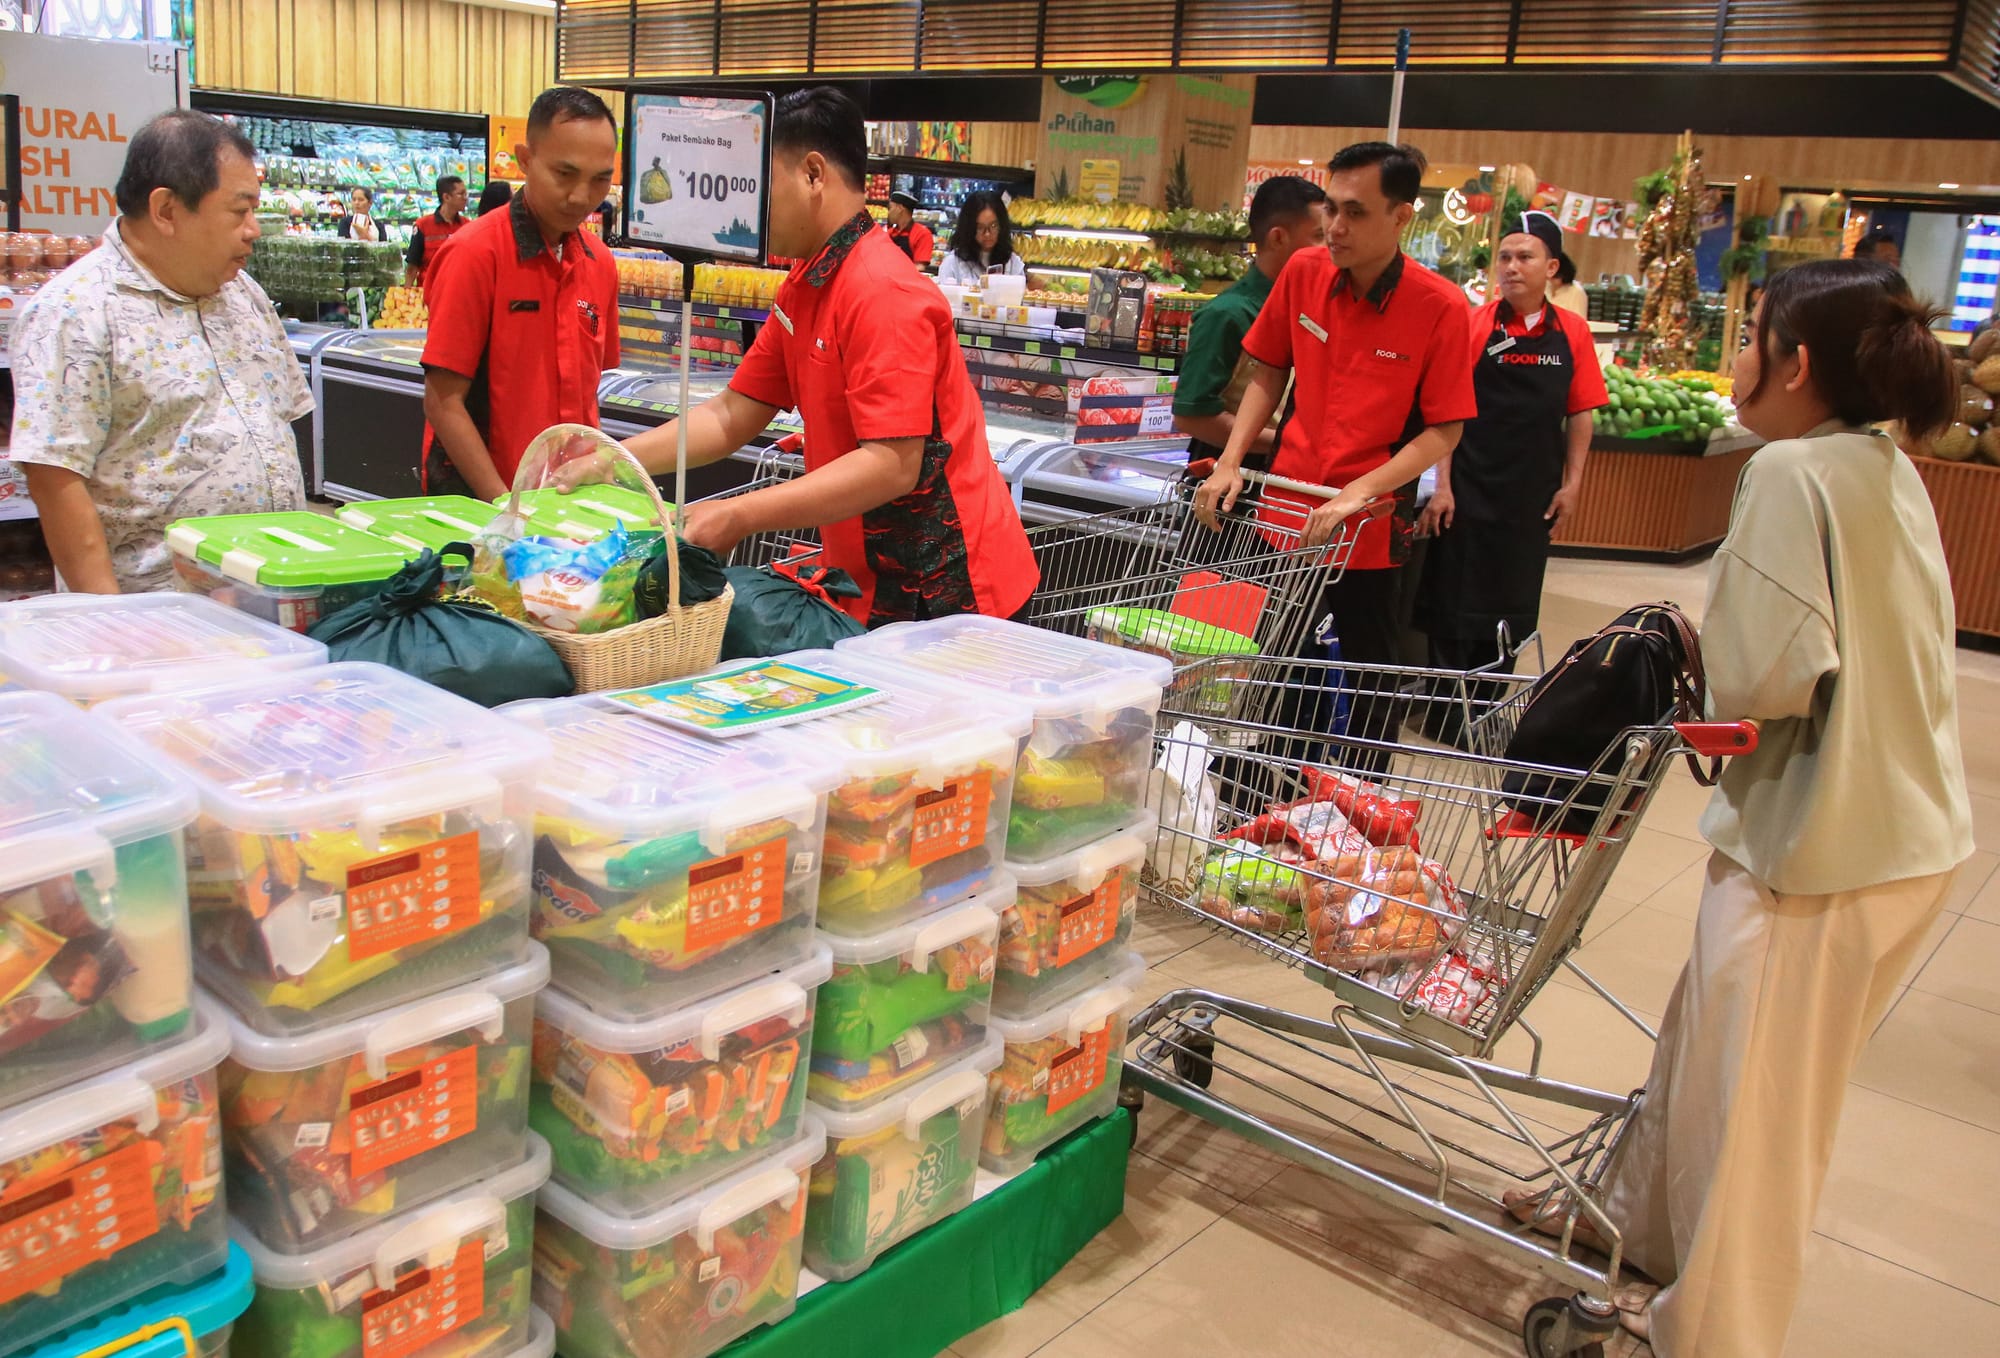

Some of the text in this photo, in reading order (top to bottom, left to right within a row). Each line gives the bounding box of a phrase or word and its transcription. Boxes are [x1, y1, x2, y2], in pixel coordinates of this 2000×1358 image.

[661, 132, 732, 149] Paket Sembako Bag
[686, 171, 728, 202] 100
[731, 176, 756, 194] 000
